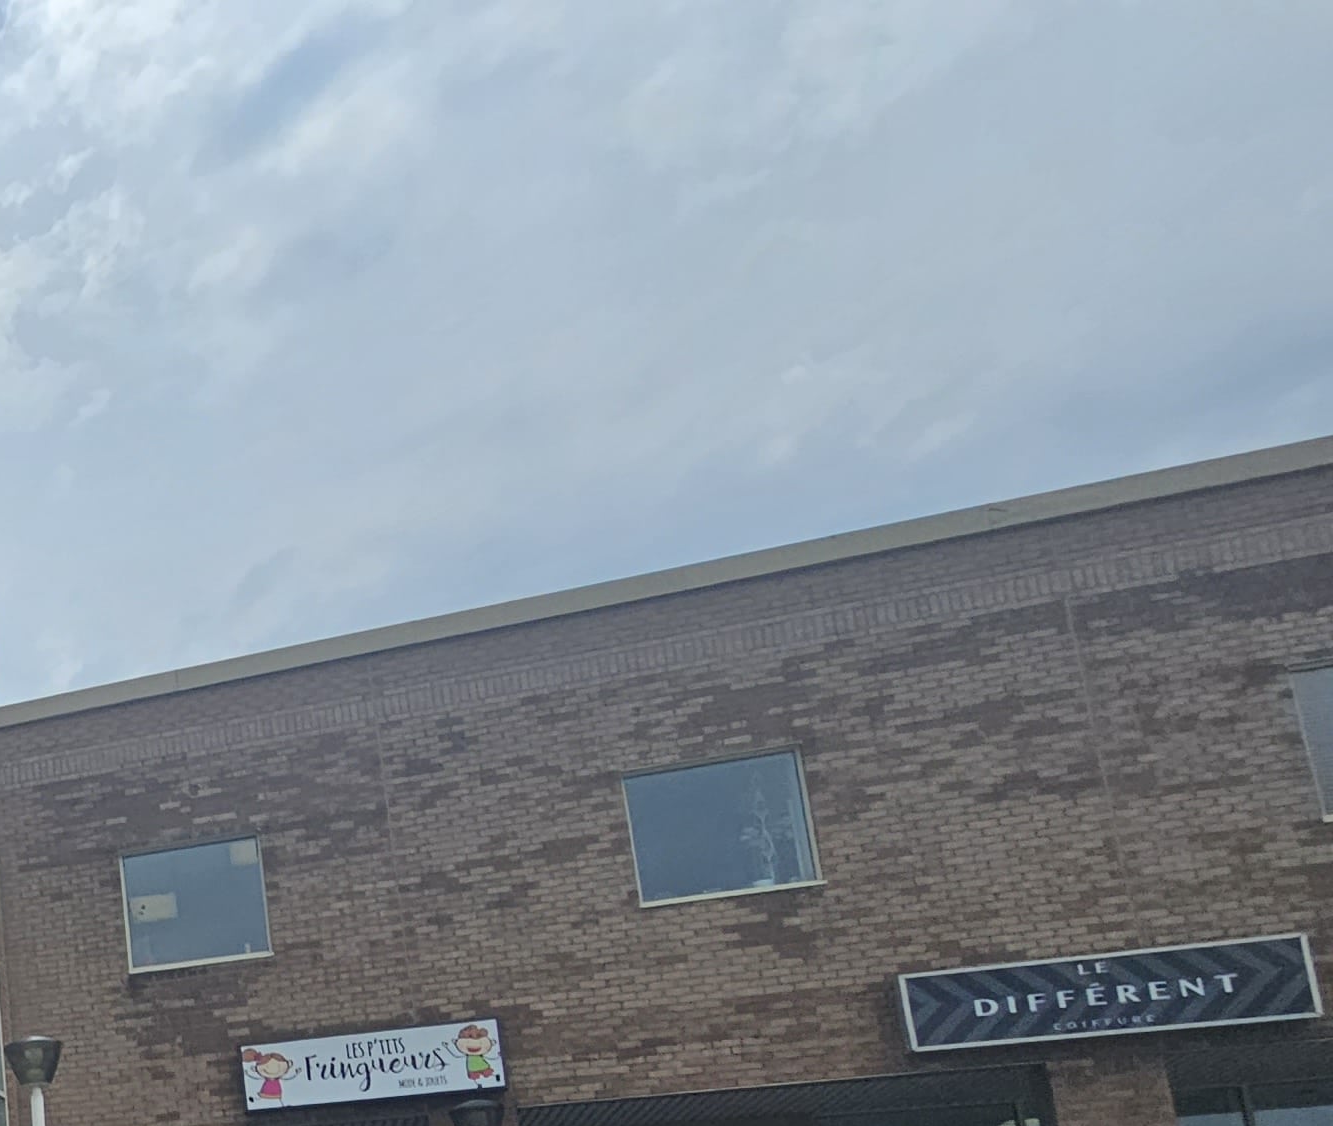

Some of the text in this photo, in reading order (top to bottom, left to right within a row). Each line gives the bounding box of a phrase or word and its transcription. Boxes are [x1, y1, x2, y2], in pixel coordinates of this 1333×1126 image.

[1076, 961, 1109, 976] LE
[973, 973, 1238, 1017] DIFFÉRENT
[1053, 1014, 1156, 1031] COIFFURE
[346, 1037, 406, 1060] LES P'TITS
[305, 1048, 450, 1092] Fringueurs
